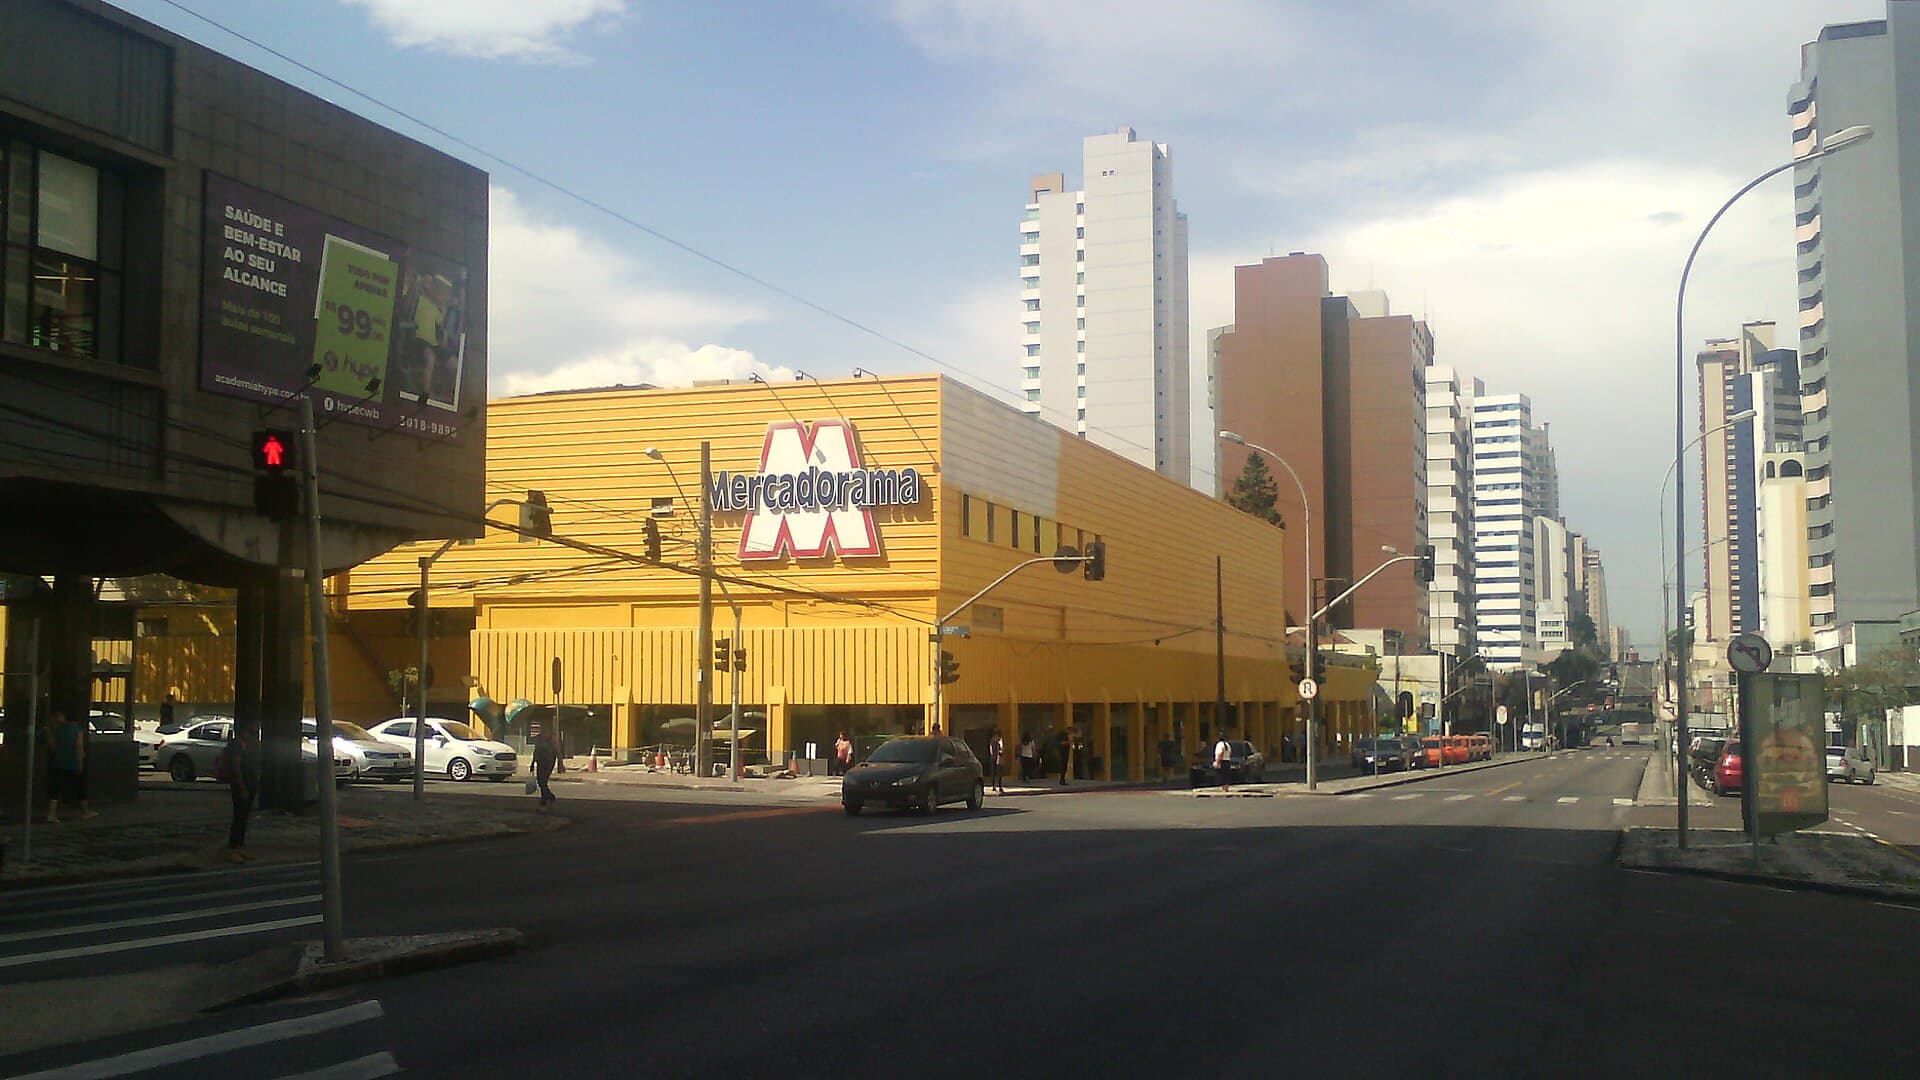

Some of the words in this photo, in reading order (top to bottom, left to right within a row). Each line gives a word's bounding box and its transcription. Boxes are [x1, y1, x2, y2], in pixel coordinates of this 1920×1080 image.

[224, 203, 272, 233] SAÚDE
[275, 222, 285, 237] E
[223, 225, 302, 263] BEM-ESTAR
[223, 246, 245, 265] AO
[248, 254, 276, 273] SEU
[223, 266, 288, 298] ALCANCE
[338, 303, 373, 340] 99
[343, 353, 380, 383] hype
[709, 465, 921, 512] Mercadorama
